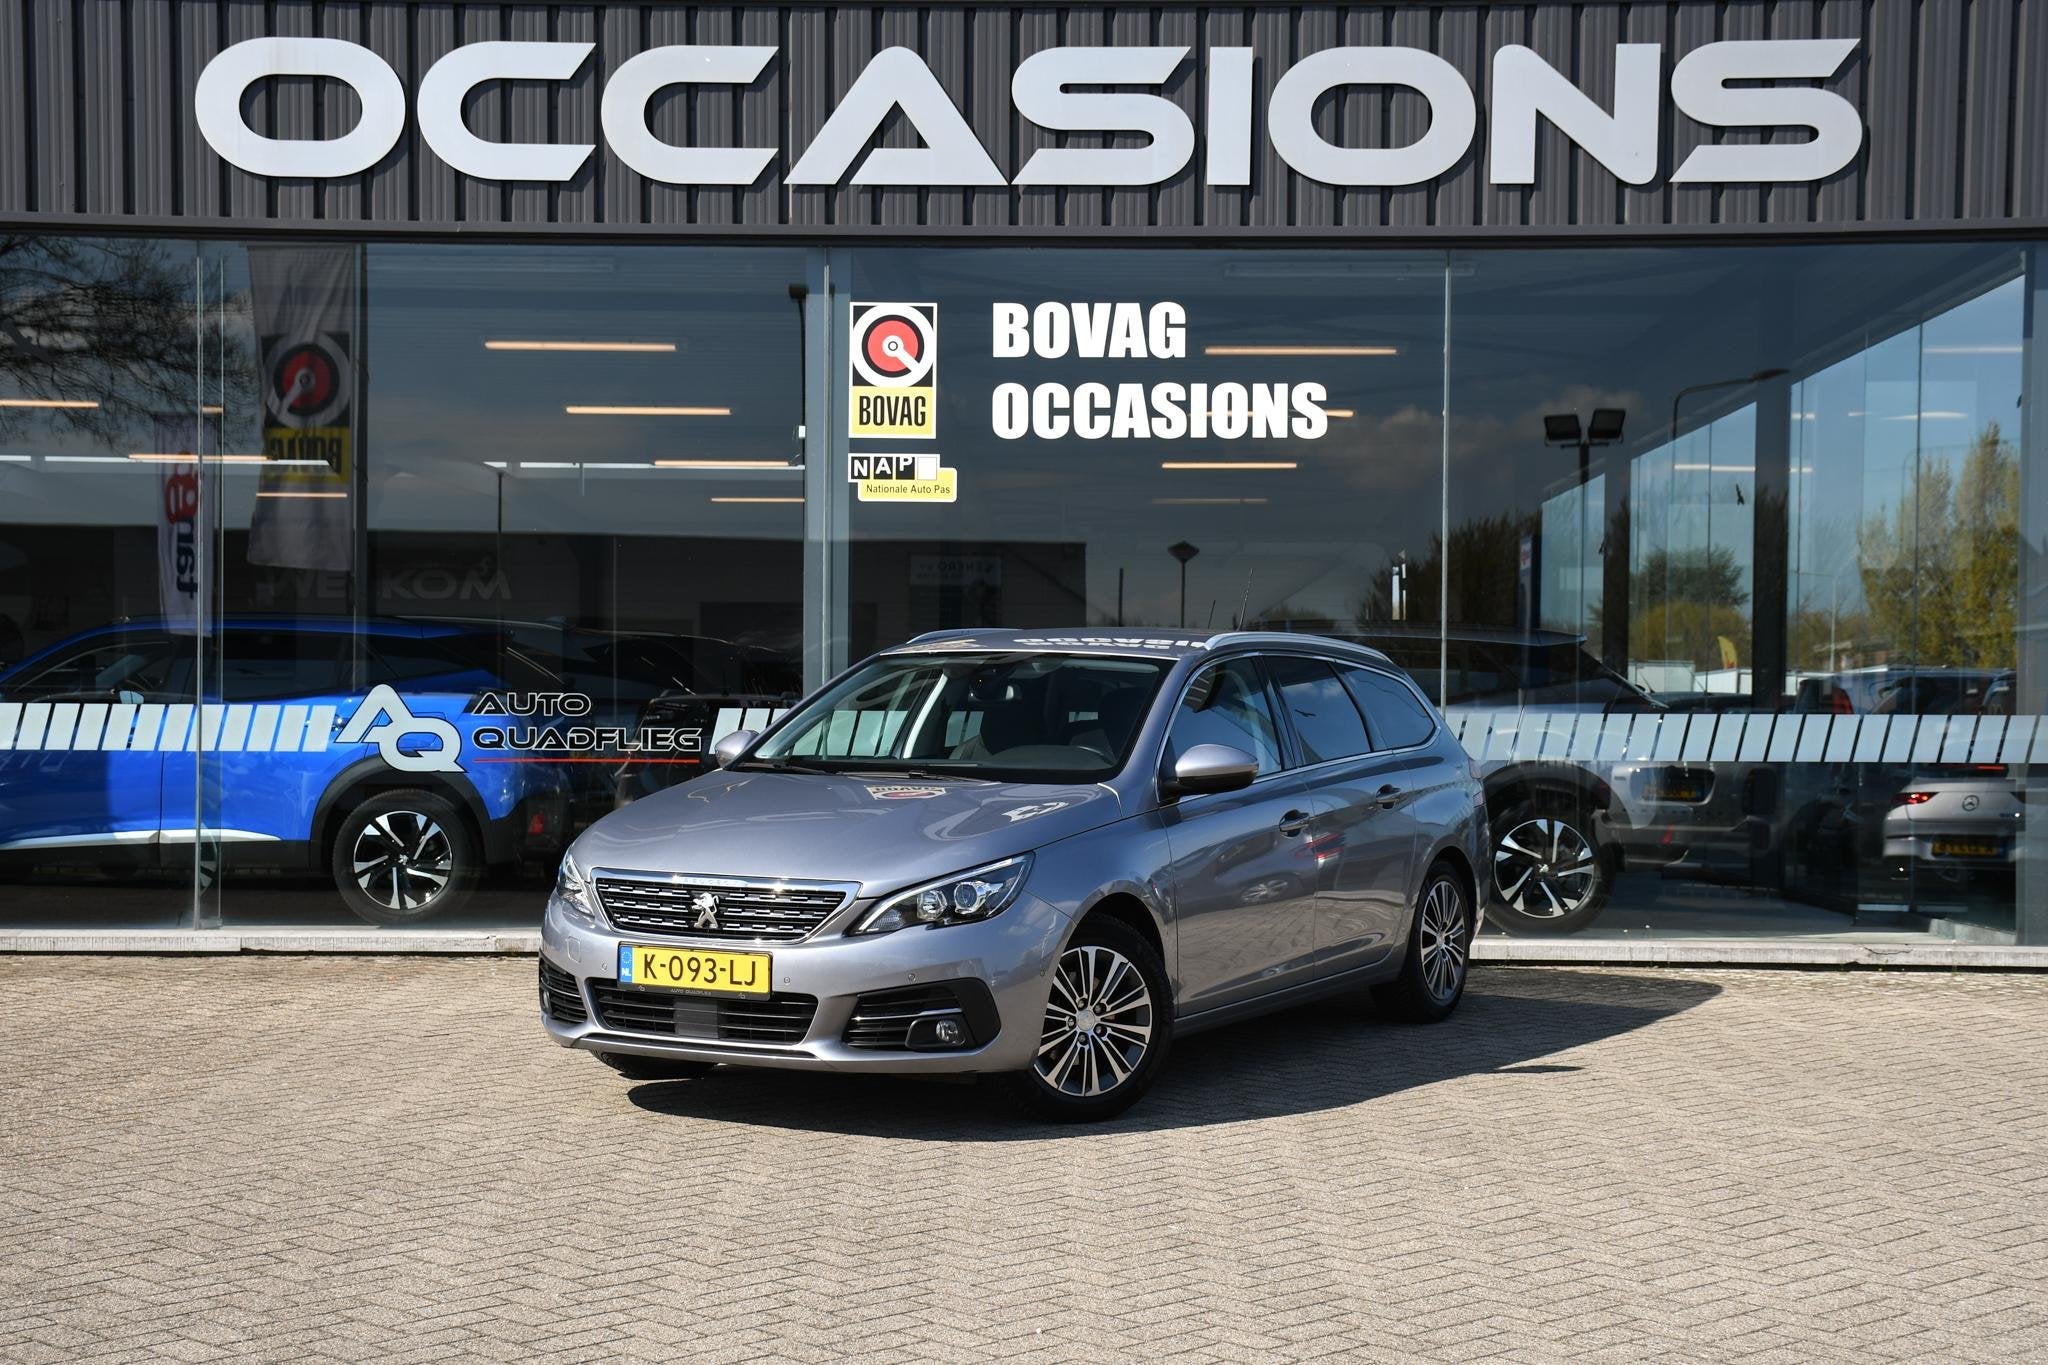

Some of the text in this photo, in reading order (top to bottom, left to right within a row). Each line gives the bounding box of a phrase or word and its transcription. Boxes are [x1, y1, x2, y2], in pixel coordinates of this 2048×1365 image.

[195, 37, 1864, 185] OCCASIONS
[992, 301, 1187, 359] BOVAG
[858, 395, 926, 426] BOVAG
[992, 381, 1328, 439] OCCASIONS
[853, 456, 913, 477] NAP
[866, 484, 951, 494] Nationale Auto Pas
[471, 692, 592, 717] AUTO
[472, 727, 702, 752] QUADFLIEG
[621, 967, 632, 977] NL
[643, 953, 756, 986] K-093-LJ
